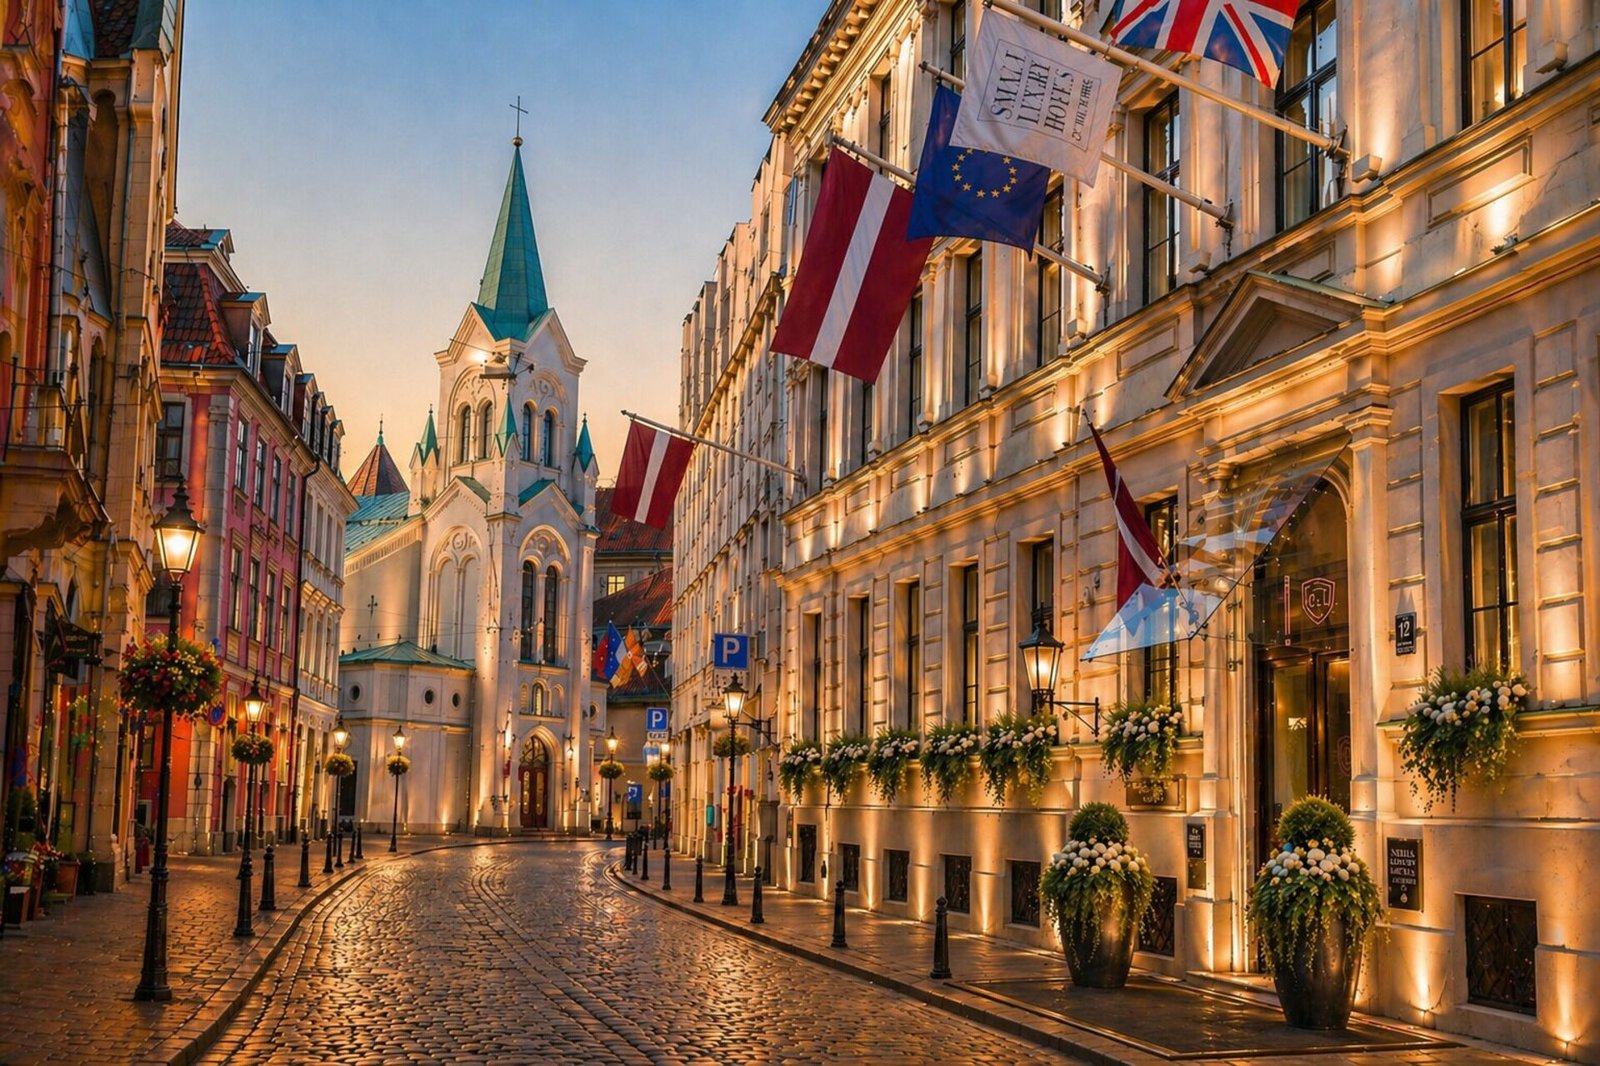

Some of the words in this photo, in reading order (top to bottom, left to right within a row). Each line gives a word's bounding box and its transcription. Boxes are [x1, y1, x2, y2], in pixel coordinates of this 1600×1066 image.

[1398, 621, 1410, 638] 12
[722, 637, 740, 663] P
[651, 710, 663, 728] P
